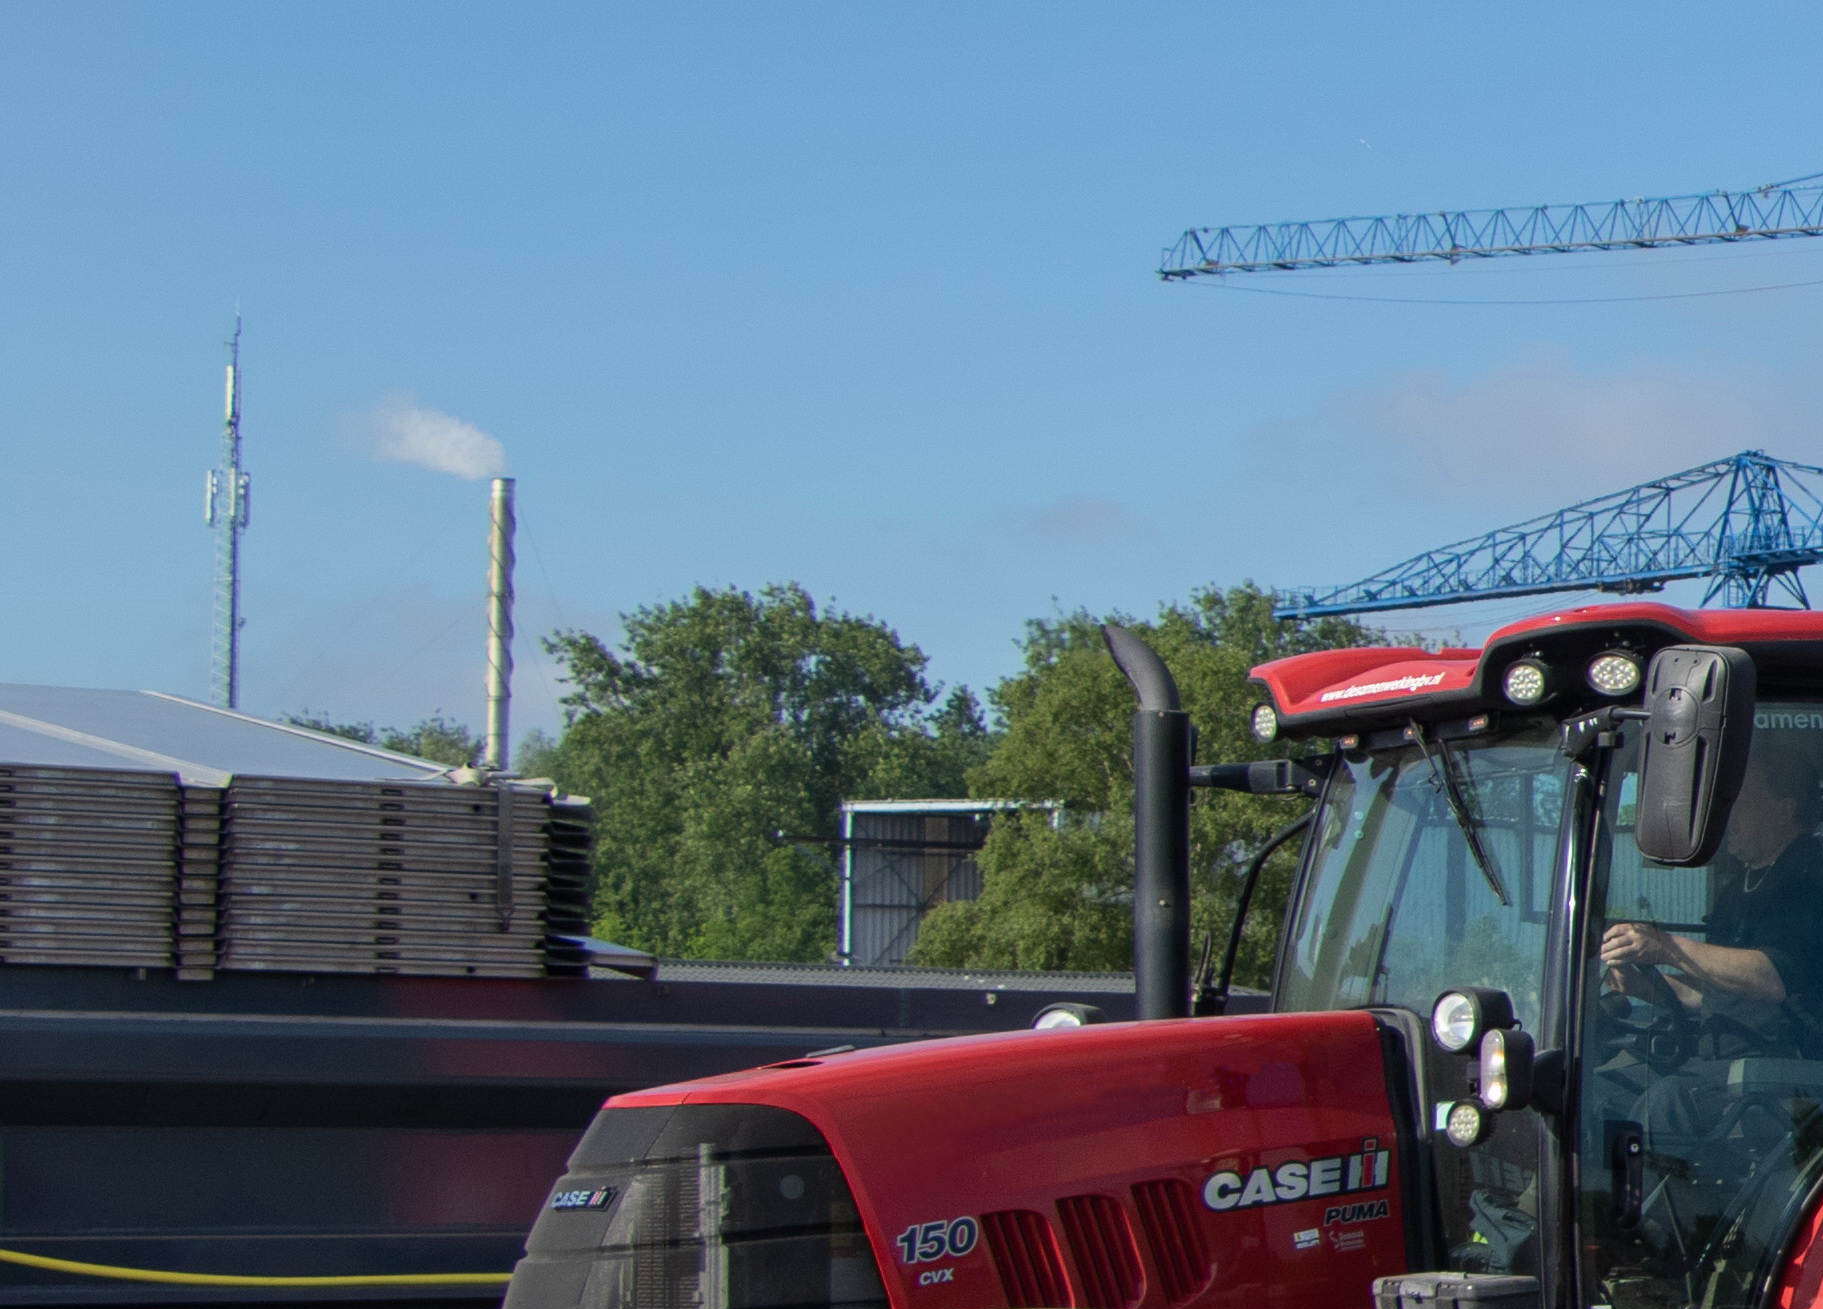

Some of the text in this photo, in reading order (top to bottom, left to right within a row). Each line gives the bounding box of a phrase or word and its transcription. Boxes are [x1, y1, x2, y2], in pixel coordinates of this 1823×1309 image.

[1203, 1157, 1343, 1211] CASE
[551, 1190, 590, 1208] CASE
[1323, 1199, 1390, 1227] PUMA
[897, 1216, 979, 1264] 150
[919, 1267, 955, 1286] CVX
